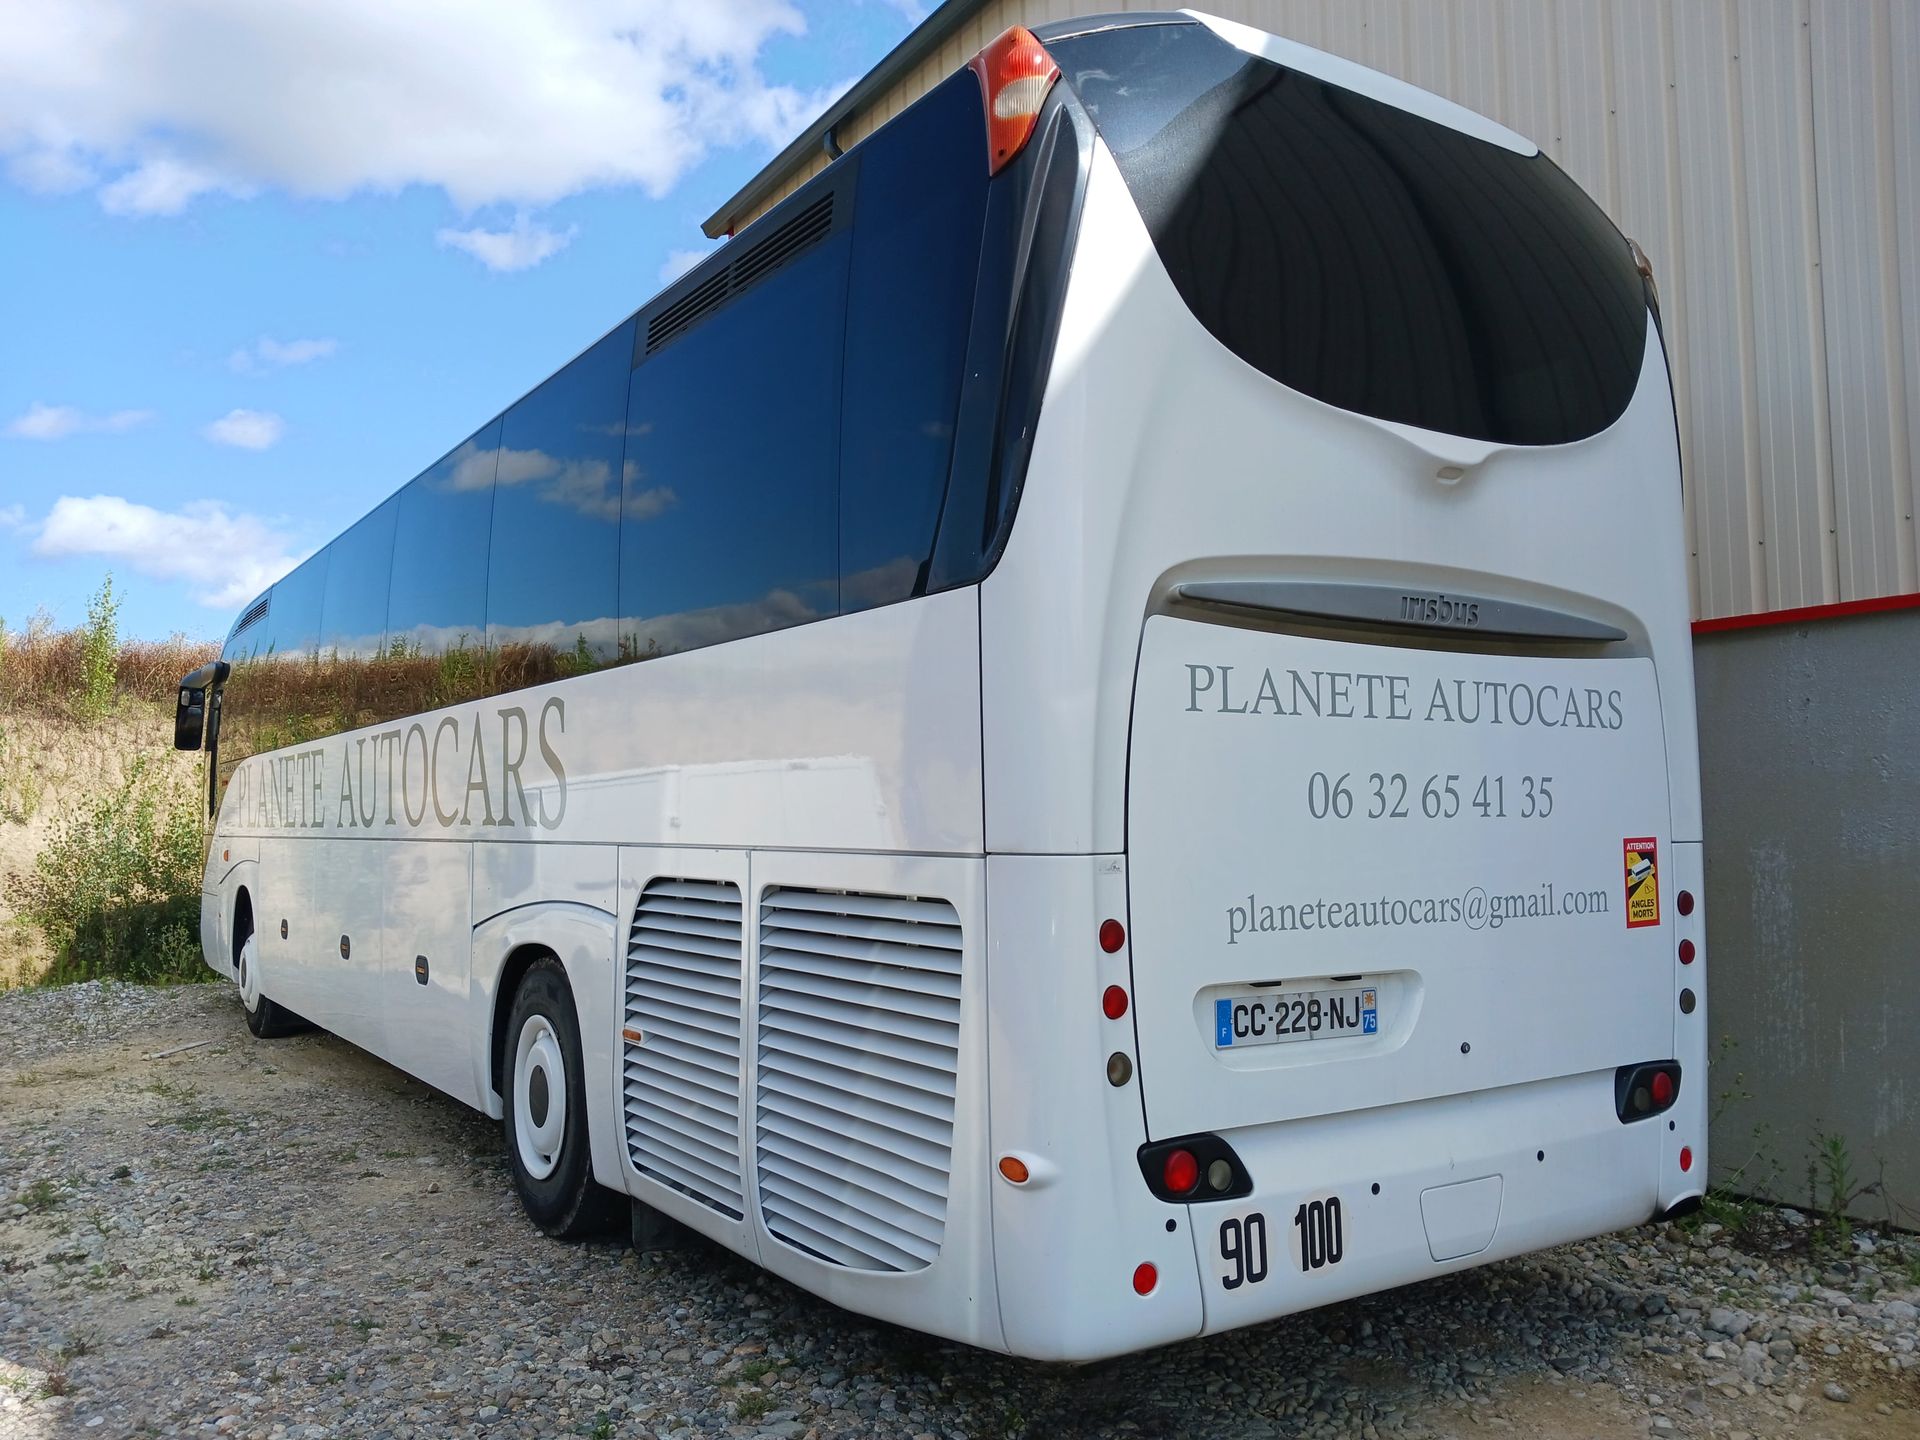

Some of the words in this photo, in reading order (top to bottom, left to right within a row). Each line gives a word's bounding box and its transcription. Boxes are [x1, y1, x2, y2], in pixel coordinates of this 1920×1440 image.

[1401, 595, 1479, 628] irisbus
[1184, 664, 1412, 721] PLANETE
[1424, 677, 1624, 731] AUTOCARS
[237, 748, 326, 829] PLANETE
[336, 696, 568, 831] AUTOCARS
[1308, 772, 1354, 819] 06
[1367, 773, 1410, 819] 32
[1421, 774, 1460, 818] 65
[1472, 775, 1507, 818] 41
[1520, 776, 1554, 819] 35
[1626, 842, 1655, 851] ATTENTION
[1226, 884, 1610, 945] planeteautocars@gmail.com
[1631, 898, 1655, 909] ANGLES
[1632, 909, 1654, 919] MORTS
[1221, 1027, 1228, 1038] F
[1233, 996, 1360, 1038] CC-228-NJ
[1363, 1013, 1376, 1030] 75
[1219, 1212, 1268, 1290] 90
[1294, 1196, 1344, 1272] 100
